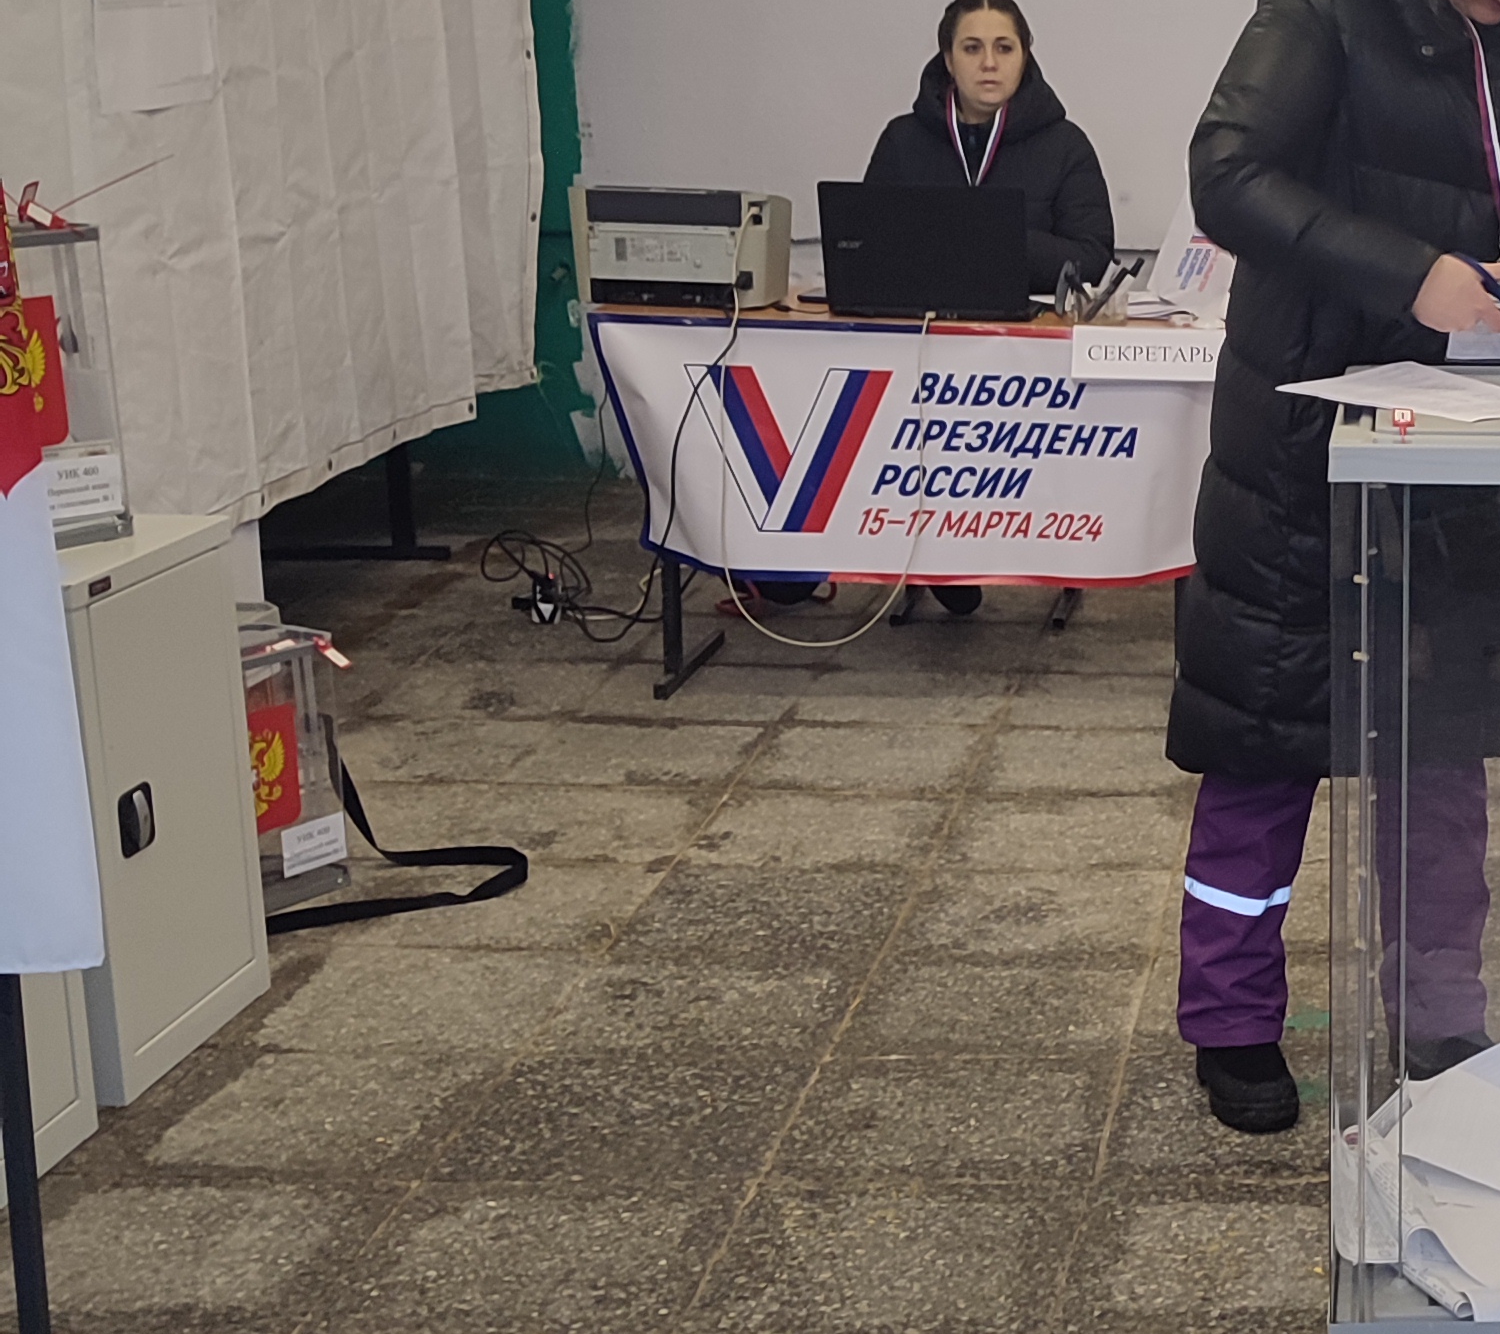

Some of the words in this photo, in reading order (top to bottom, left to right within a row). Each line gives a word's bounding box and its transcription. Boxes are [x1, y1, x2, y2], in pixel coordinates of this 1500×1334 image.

[1087, 344, 1214, 363] СЕКРЕТАРЬ
[911, 372, 1087, 410] ВЫБОРЫ
[890, 418, 1139, 459] ПРЕЗИДЕНТА
[871, 464, 1033, 499] РОССИИ
[937, 510, 1033, 539] МАРТА
[1036, 512, 1104, 542] 2024
